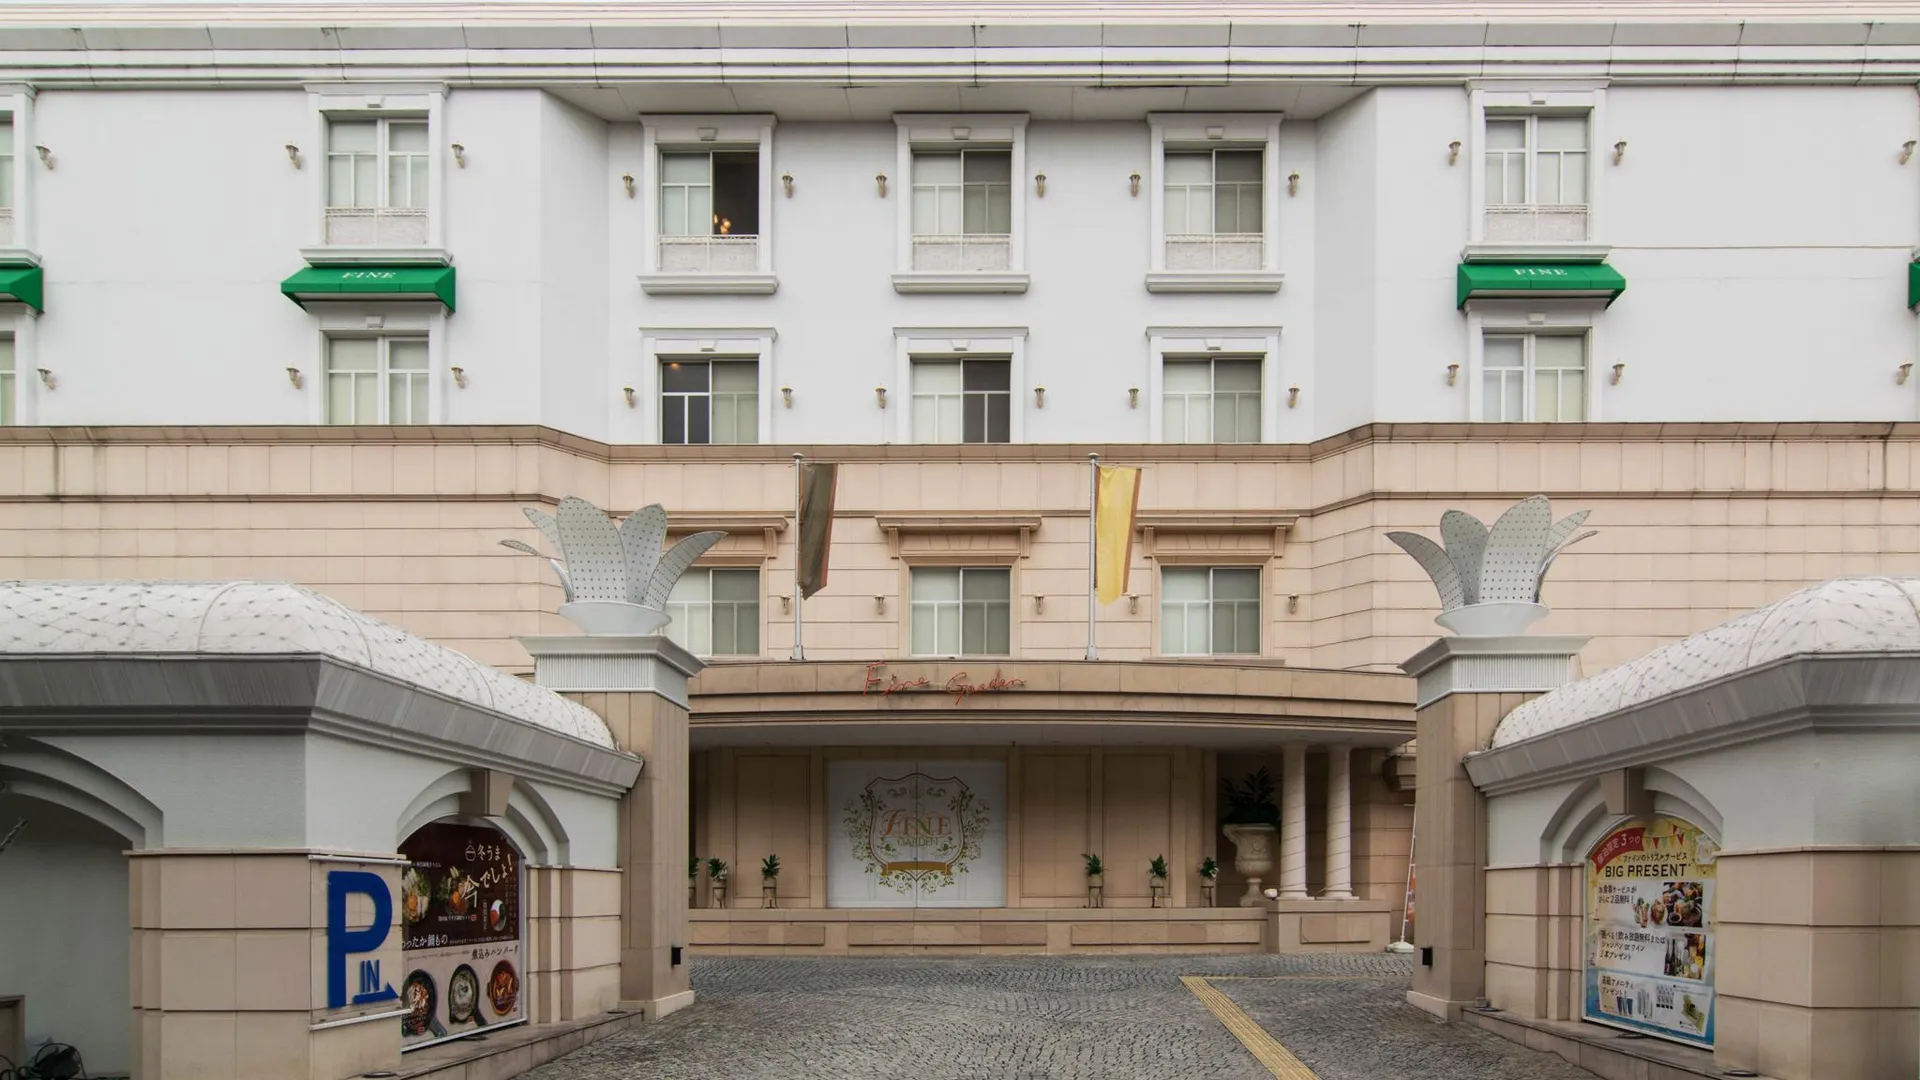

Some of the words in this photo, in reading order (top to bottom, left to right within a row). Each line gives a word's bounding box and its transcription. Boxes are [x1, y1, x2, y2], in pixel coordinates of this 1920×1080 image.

[342, 271, 396, 279] FINE
[1513, 268, 1568, 276] FINE
[863, 661, 930, 696] Fine
[945, 668, 1028, 705] Garden
[880, 809, 952, 836] FINE
[1605, 865, 1624, 877] BIG
[1628, 863, 1687, 877] PRESENT
[328, 871, 393, 1009] P
[360, 960, 380, 993] IN
